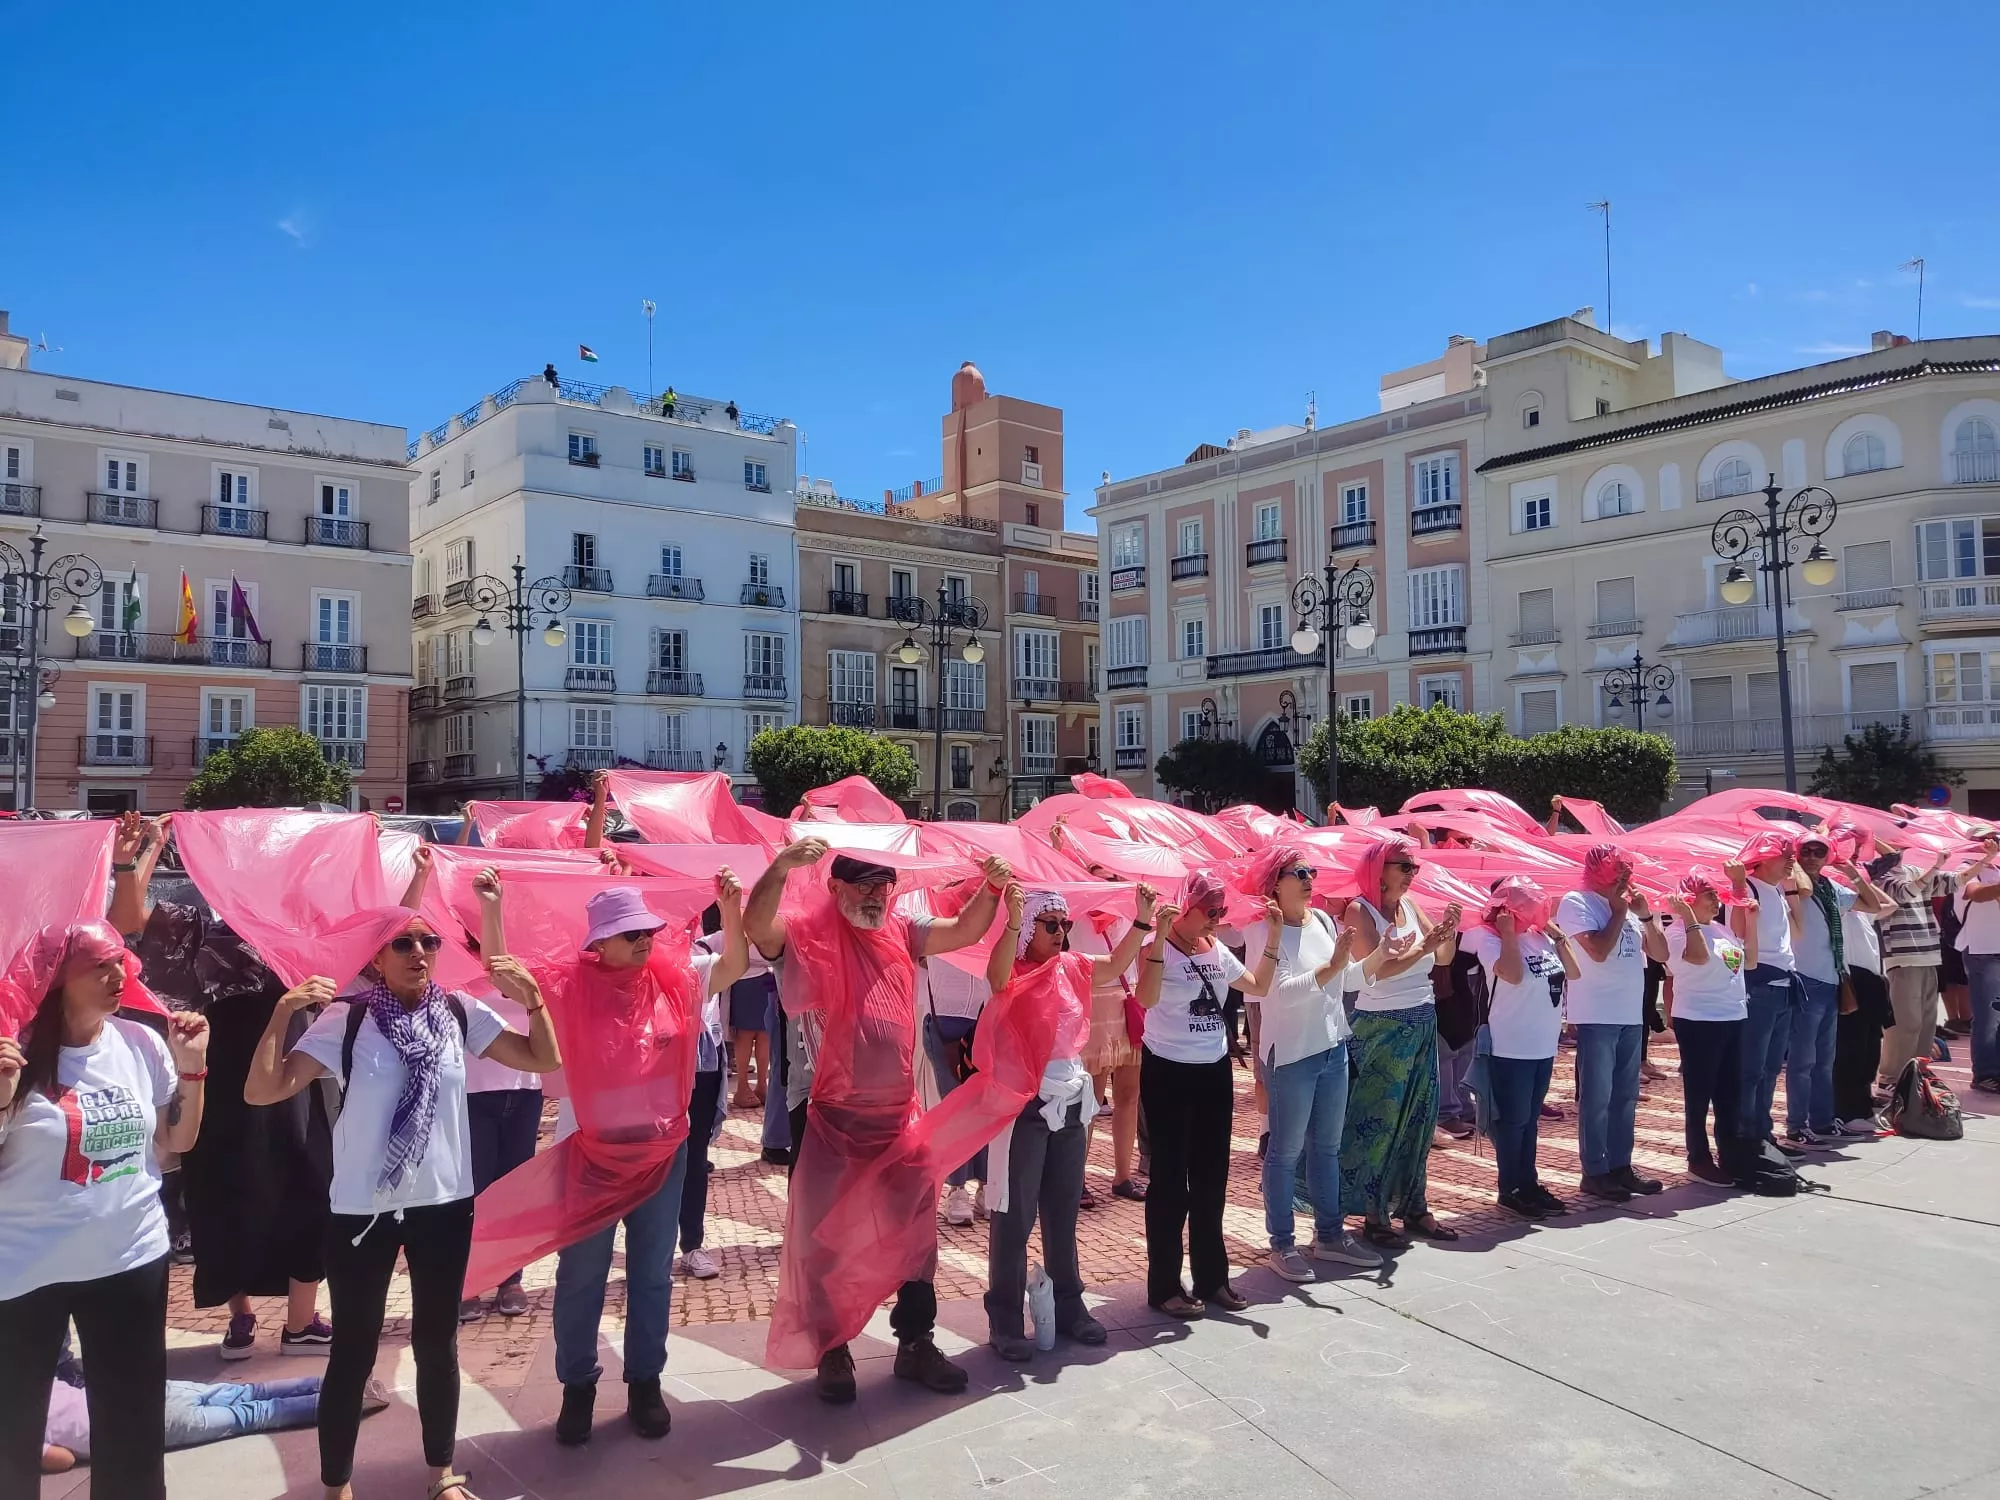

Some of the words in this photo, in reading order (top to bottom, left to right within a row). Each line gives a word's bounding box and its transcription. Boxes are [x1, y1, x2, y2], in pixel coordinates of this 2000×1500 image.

[81, 1087, 134, 1109] GAZA
[86, 1104, 143, 1124] LIBRE
[87, 1121, 145, 1137] PALESTINA
